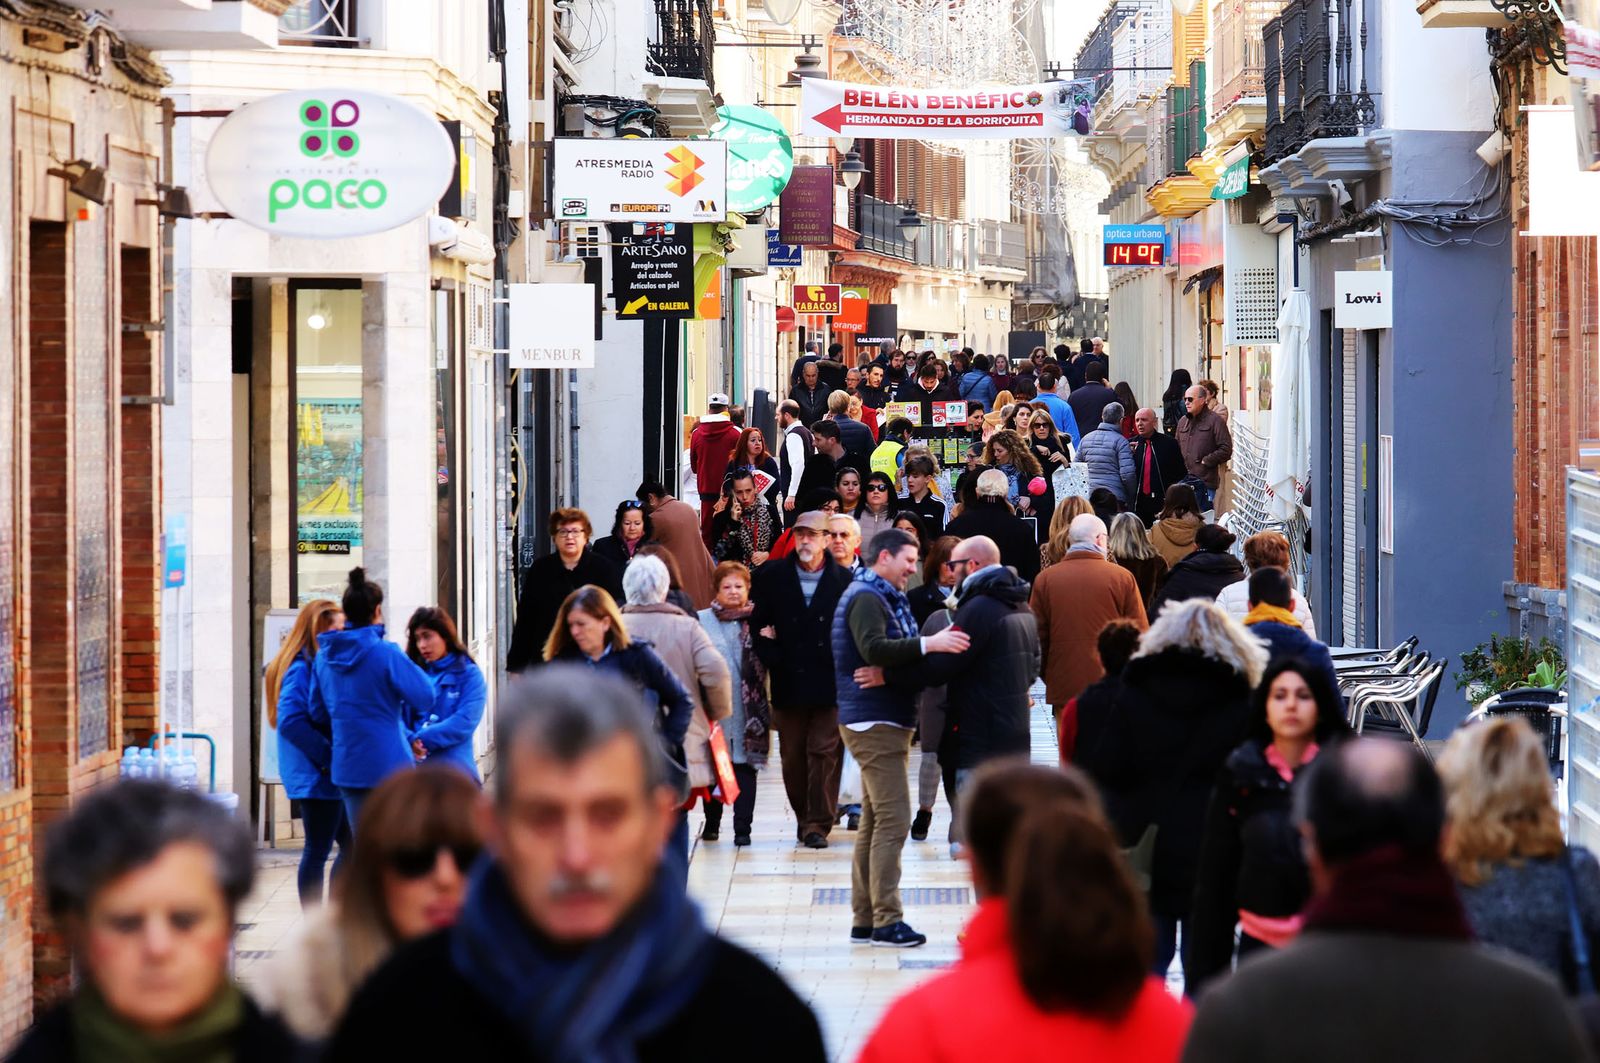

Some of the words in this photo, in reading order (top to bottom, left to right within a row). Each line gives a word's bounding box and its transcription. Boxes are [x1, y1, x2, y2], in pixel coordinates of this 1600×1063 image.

[843, 88, 919, 109] BELÉN
[845, 114, 926, 125] HERMANDAD
[928, 115, 944, 125] DE
[947, 115, 963, 125] LA
[965, 115, 1039, 126] BORRIQUITA
[575, 159, 653, 169] ATRESMEDIA
[621, 170, 654, 179] RADIO
[268, 178, 387, 223] paco
[1106, 229, 1132, 240] optica
[1133, 229, 1162, 238] urbano
[622, 236, 636, 245] EL
[1112, 246, 1130, 264] 14
[630, 261, 654, 270] Arreglo
[636, 271, 647, 279] del
[648, 271, 673, 279] calzado
[667, 281, 680, 291] piel
[1345, 292, 1382, 304] Lowi
[647, 302, 658, 311] EN
[796, 302, 838, 311] TABACOS
[833, 321, 863, 330] orange
[521, 348, 582, 361] MENBUR
